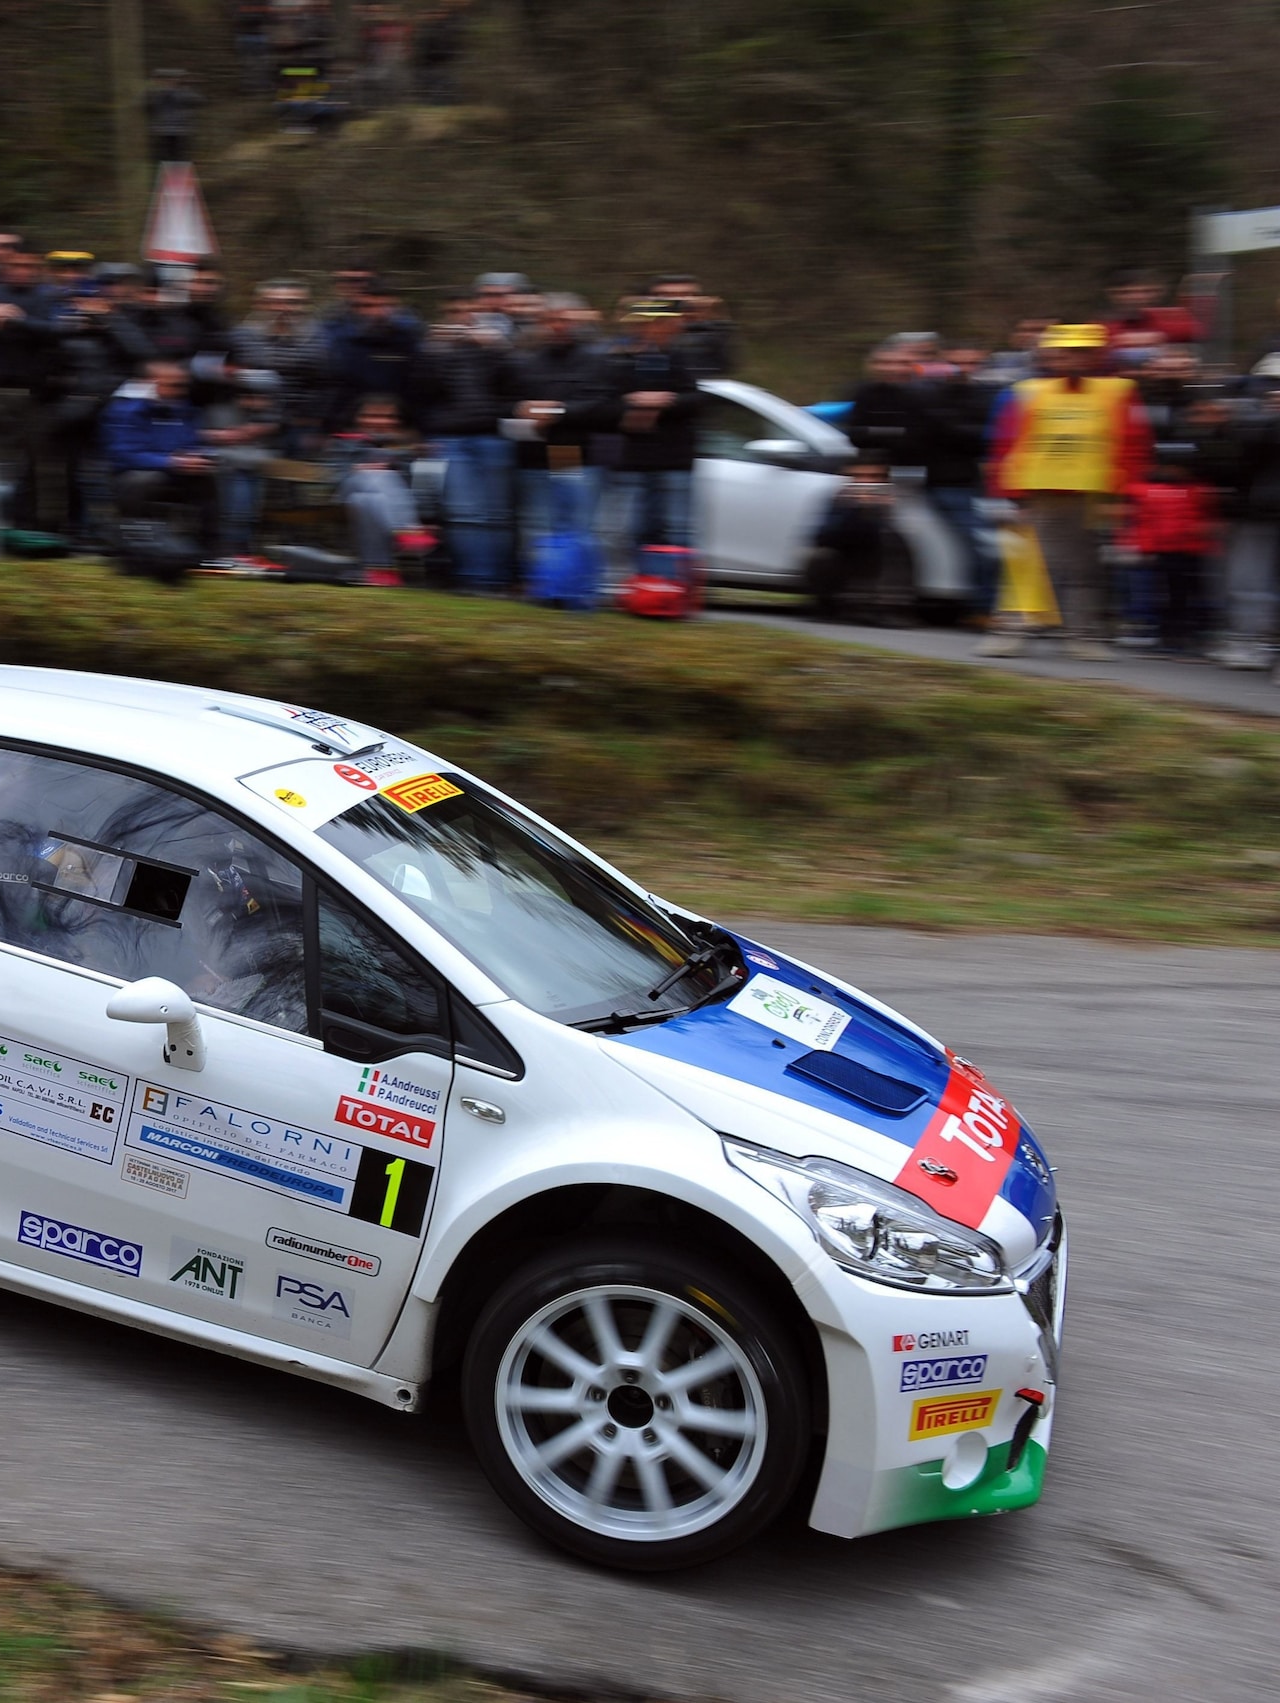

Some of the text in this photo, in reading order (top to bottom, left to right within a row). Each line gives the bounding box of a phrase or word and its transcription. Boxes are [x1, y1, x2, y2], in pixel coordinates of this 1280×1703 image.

[383, 774, 459, 810] PIRELLI
[16, 1079, 54, 1099] C.A.V.I.
[58, 1092, 87, 1109] S.R.L.
[89, 1102, 116, 1124] EC
[377, 1087, 438, 1116] P.Andreucci
[380, 1073, 441, 1101] A.Andreussi
[8, 1116, 36, 1130] Validation
[37, 1126, 49, 1134] and
[49, 1128, 77, 1143] Technical
[76, 1137, 100, 1151] Services
[175, 1096, 351, 1160] FALORNI
[340, 1100, 429, 1145] TOTAL
[152, 1121, 311, 1177] Logistica integrata del freddo
[173, 1113, 348, 1174] OPIFICIO DEL FARMACO
[126, 1168, 183, 1190] GARFAGNANA
[127, 1162, 184, 1186] CASTELNUOVO DI
[145, 1181, 166, 1191] AGOSTO
[379, 1157, 407, 1228] 1
[22, 1215, 141, 1269] sparco
[197, 1248, 245, 1267] FONDAZIONE
[169, 1255, 244, 1300] ANT
[184, 1279, 225, 1297] 1978 ONLUS
[276, 1275, 350, 1319] PSA
[291, 1312, 332, 1330] BANCA
[918, 1330, 969, 1349] GENART
[903, 1357, 985, 1388] sparco
[916, 1397, 993, 1432] PIRELLI
